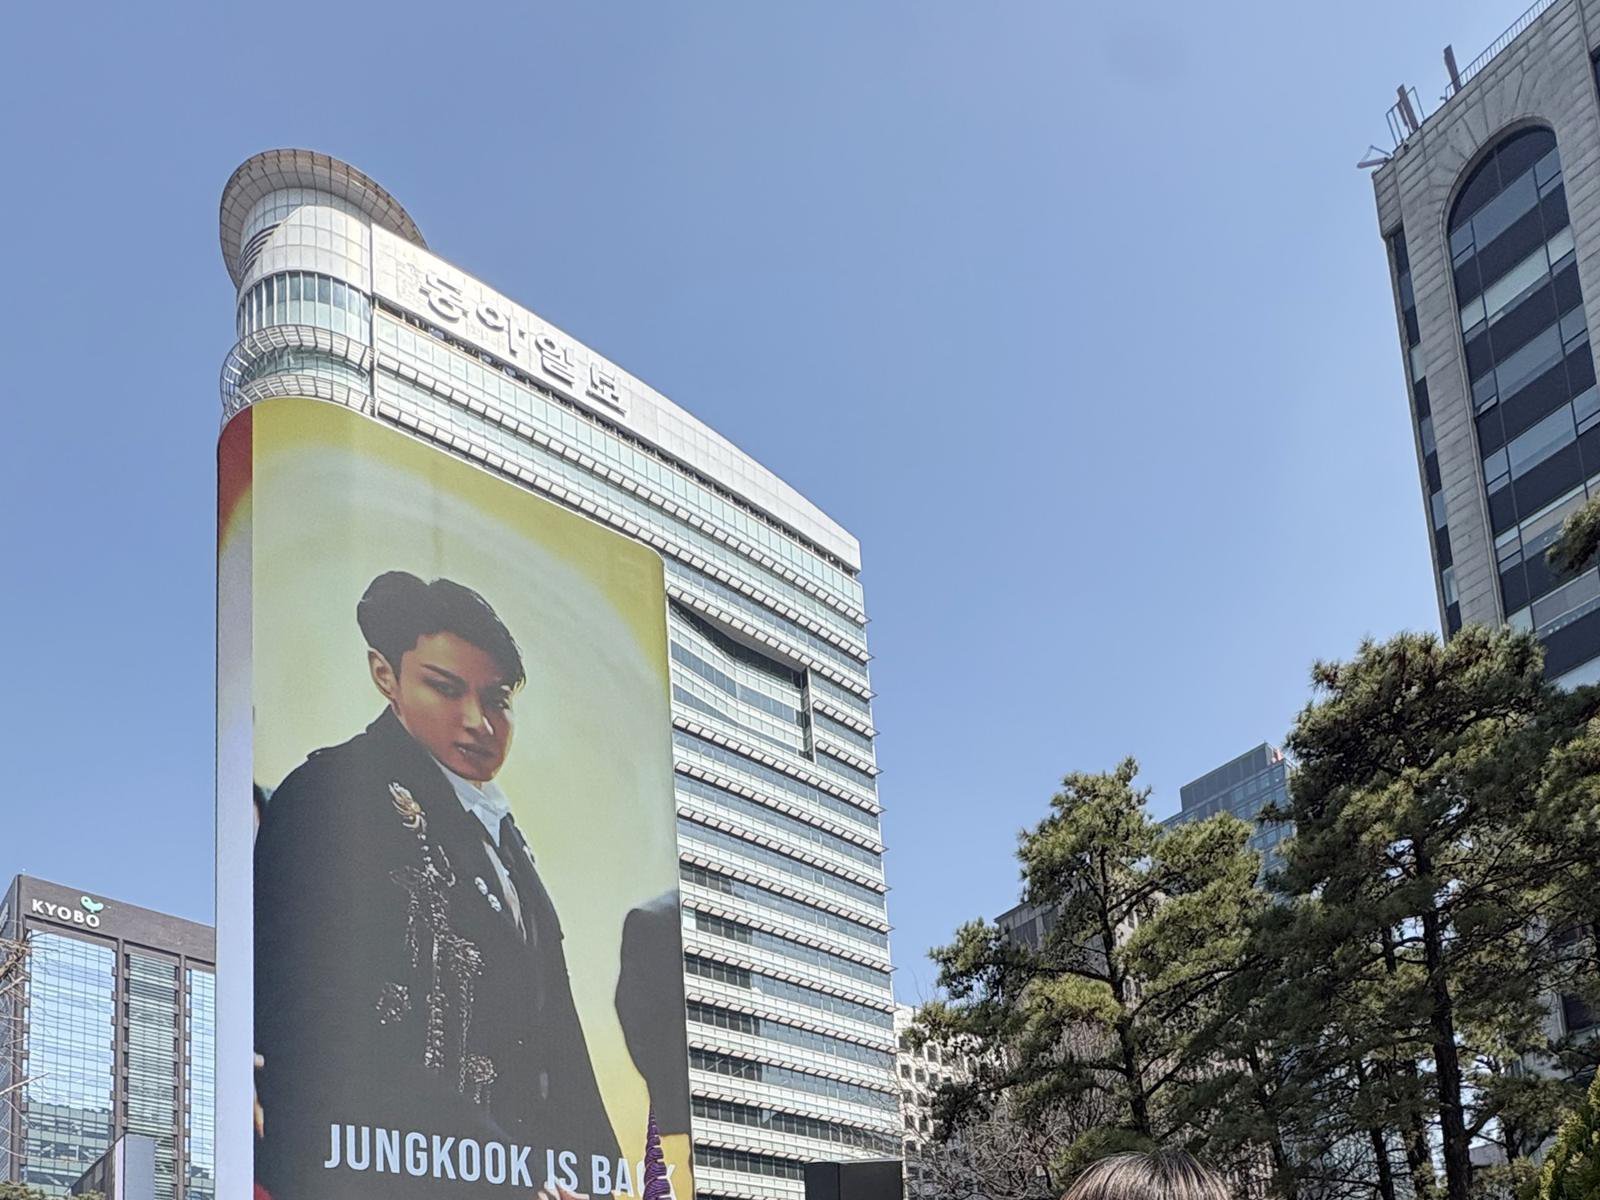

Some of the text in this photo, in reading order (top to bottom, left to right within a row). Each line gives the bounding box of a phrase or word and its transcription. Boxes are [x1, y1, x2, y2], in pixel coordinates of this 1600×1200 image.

[418, 270, 629, 417] 동아일보
[31, 898, 101, 928] KYOBO
[324, 1123, 533, 1187] JUNGKOOK
[546, 1149, 579, 1191] IS
